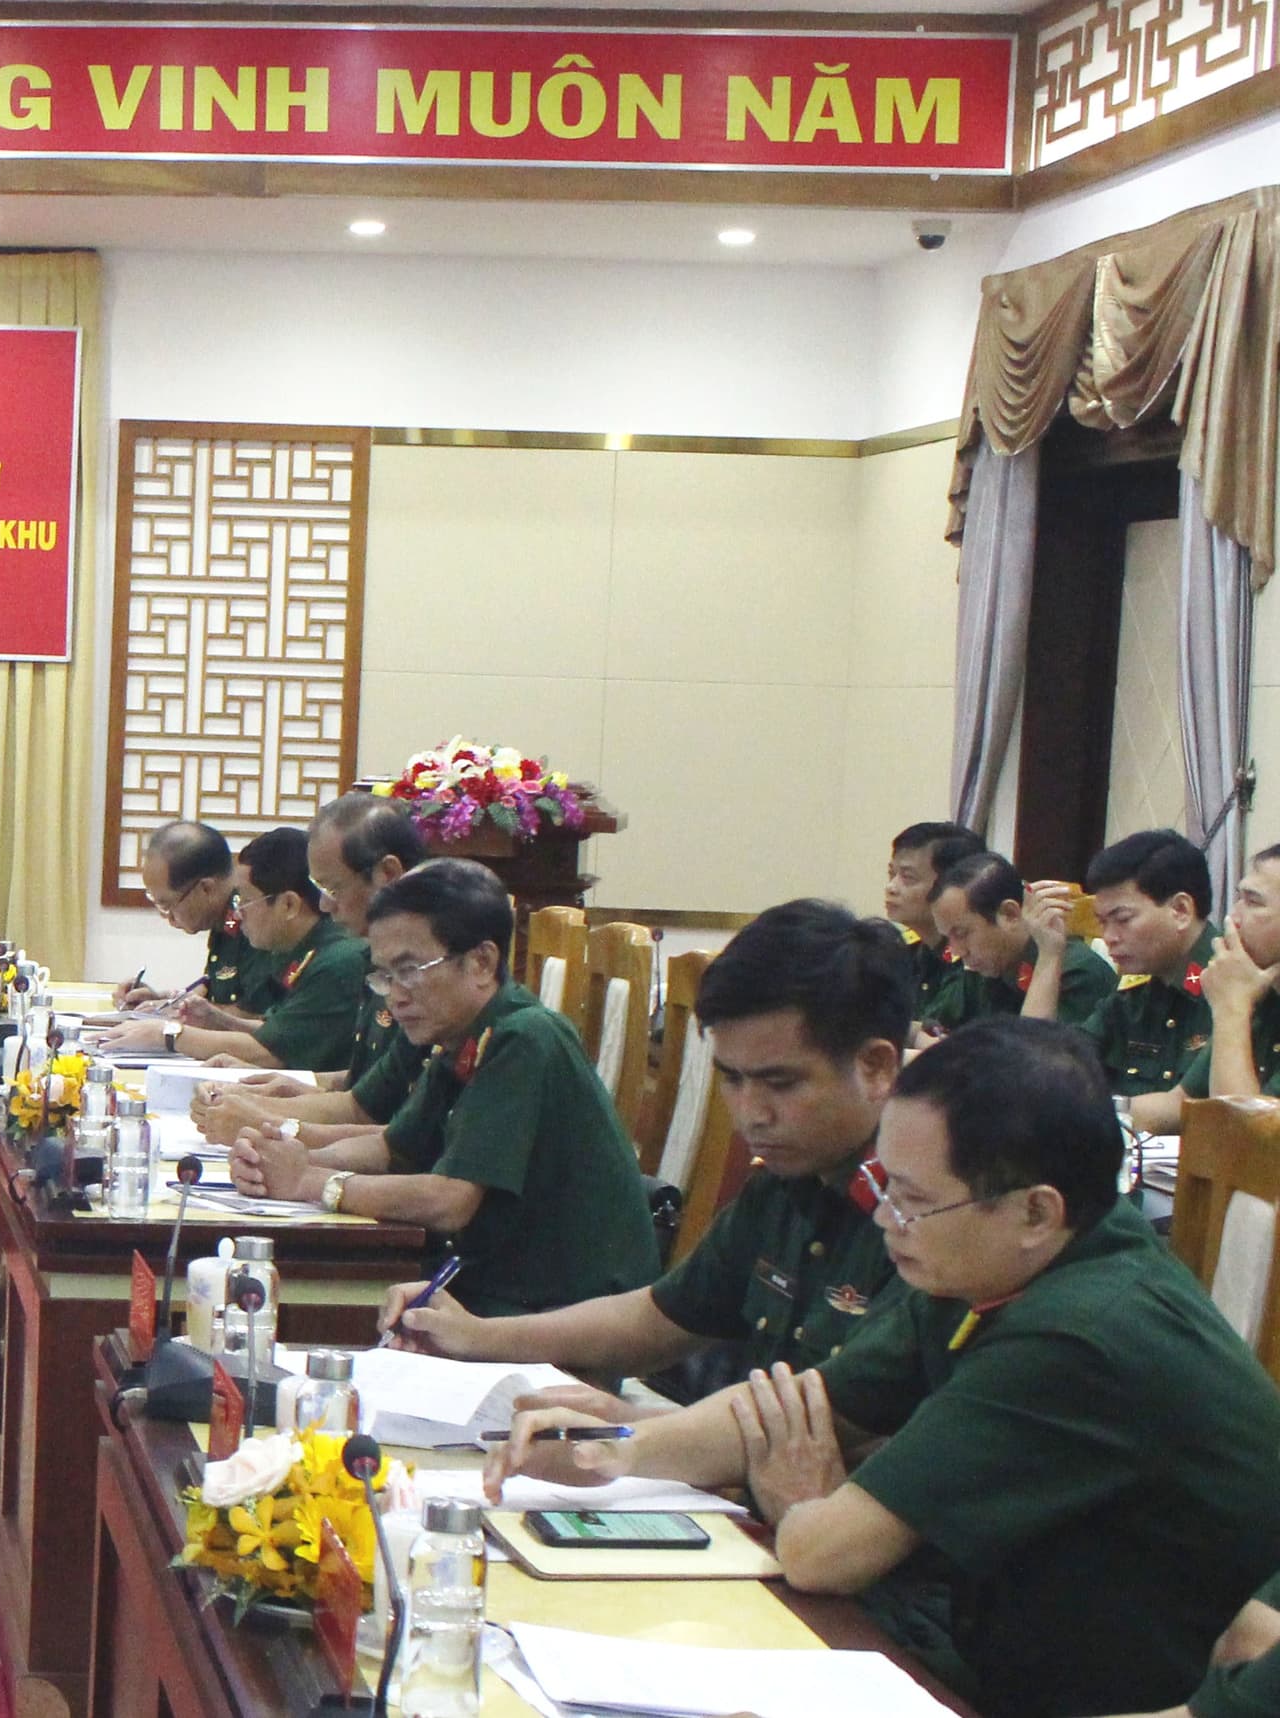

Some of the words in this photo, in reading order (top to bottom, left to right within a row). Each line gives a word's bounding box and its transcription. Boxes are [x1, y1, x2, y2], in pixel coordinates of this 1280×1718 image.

[89, 65, 328, 132] VINH
[377, 54, 682, 140] MUÔN
[727, 63, 960, 144] NĂM
